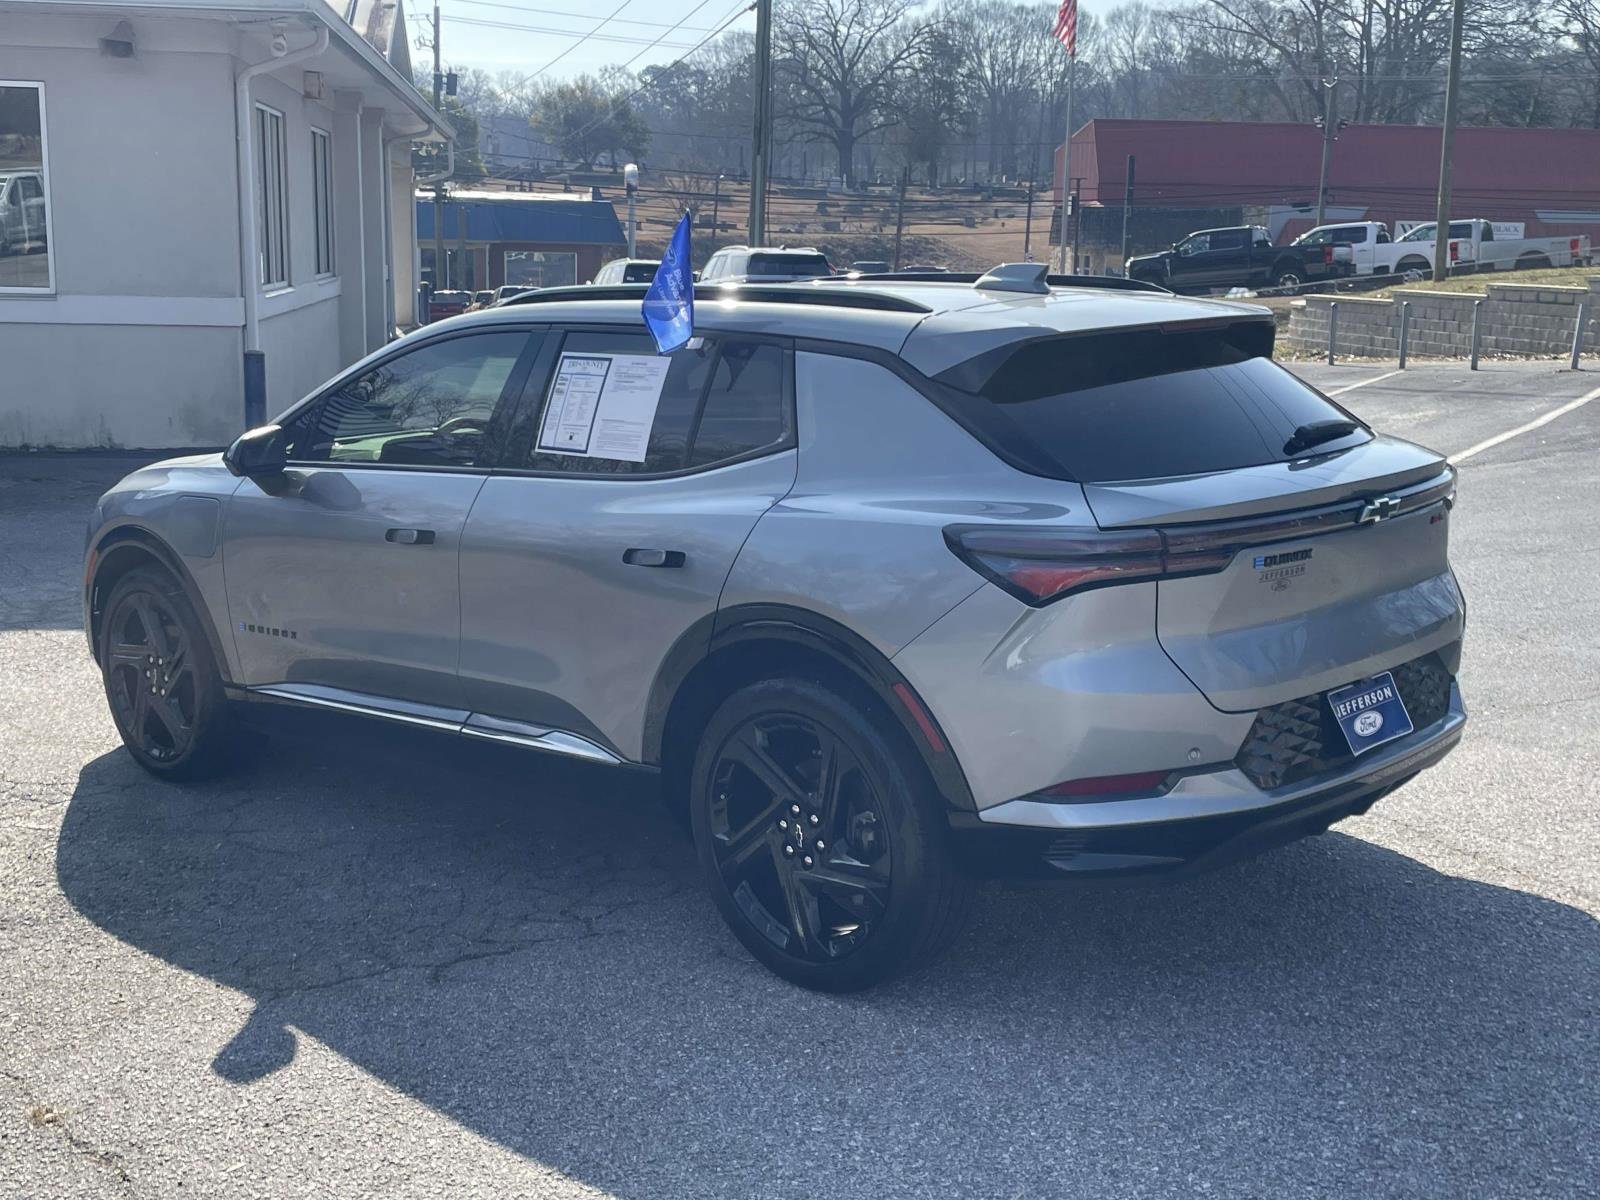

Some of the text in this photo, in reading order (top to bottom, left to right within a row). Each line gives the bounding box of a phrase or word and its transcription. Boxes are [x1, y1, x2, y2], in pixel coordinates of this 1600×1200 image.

[673, 268, 685, 290] Blue
[1253, 548, 1313, 569] EQUINOX
[1336, 686, 1393, 718] JEFFERSON
[1359, 715, 1378, 733] Ford
